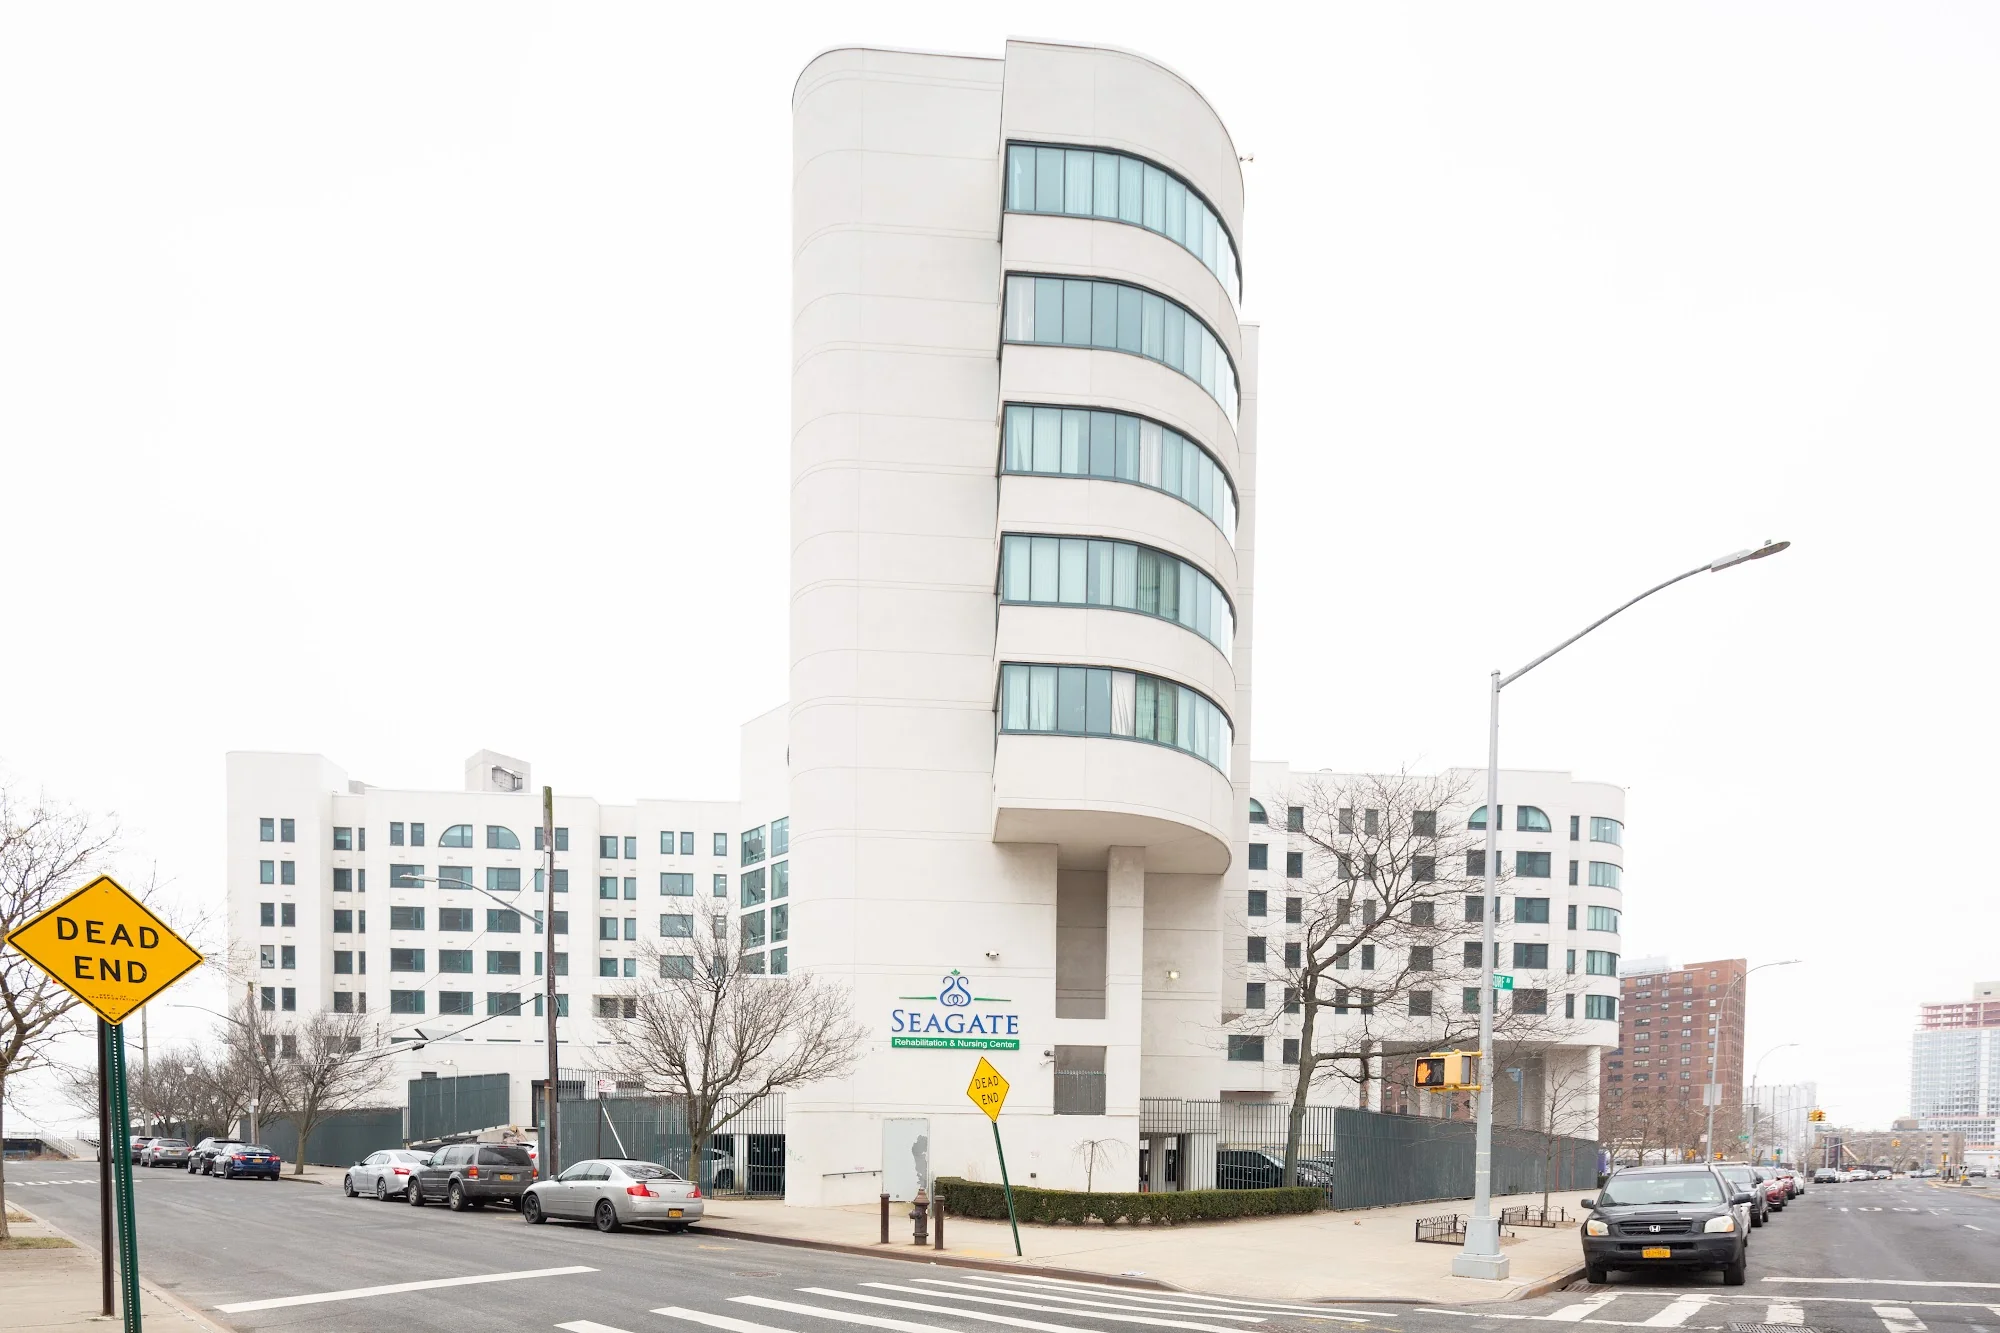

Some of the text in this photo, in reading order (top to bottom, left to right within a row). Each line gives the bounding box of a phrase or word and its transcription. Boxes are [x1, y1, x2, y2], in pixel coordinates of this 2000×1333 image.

[57, 917, 159, 949] DEAD
[74, 955, 148, 984] END
[891, 1009, 1019, 1035] SEAGATE
[894, 1038, 948, 1047] Rehabilitation
[957, 1040, 988, 1049] Nursing
[989, 1040, 1016, 1048] Center
[975, 1075, 999, 1090] DEAD
[981, 1092, 999, 1105] END
